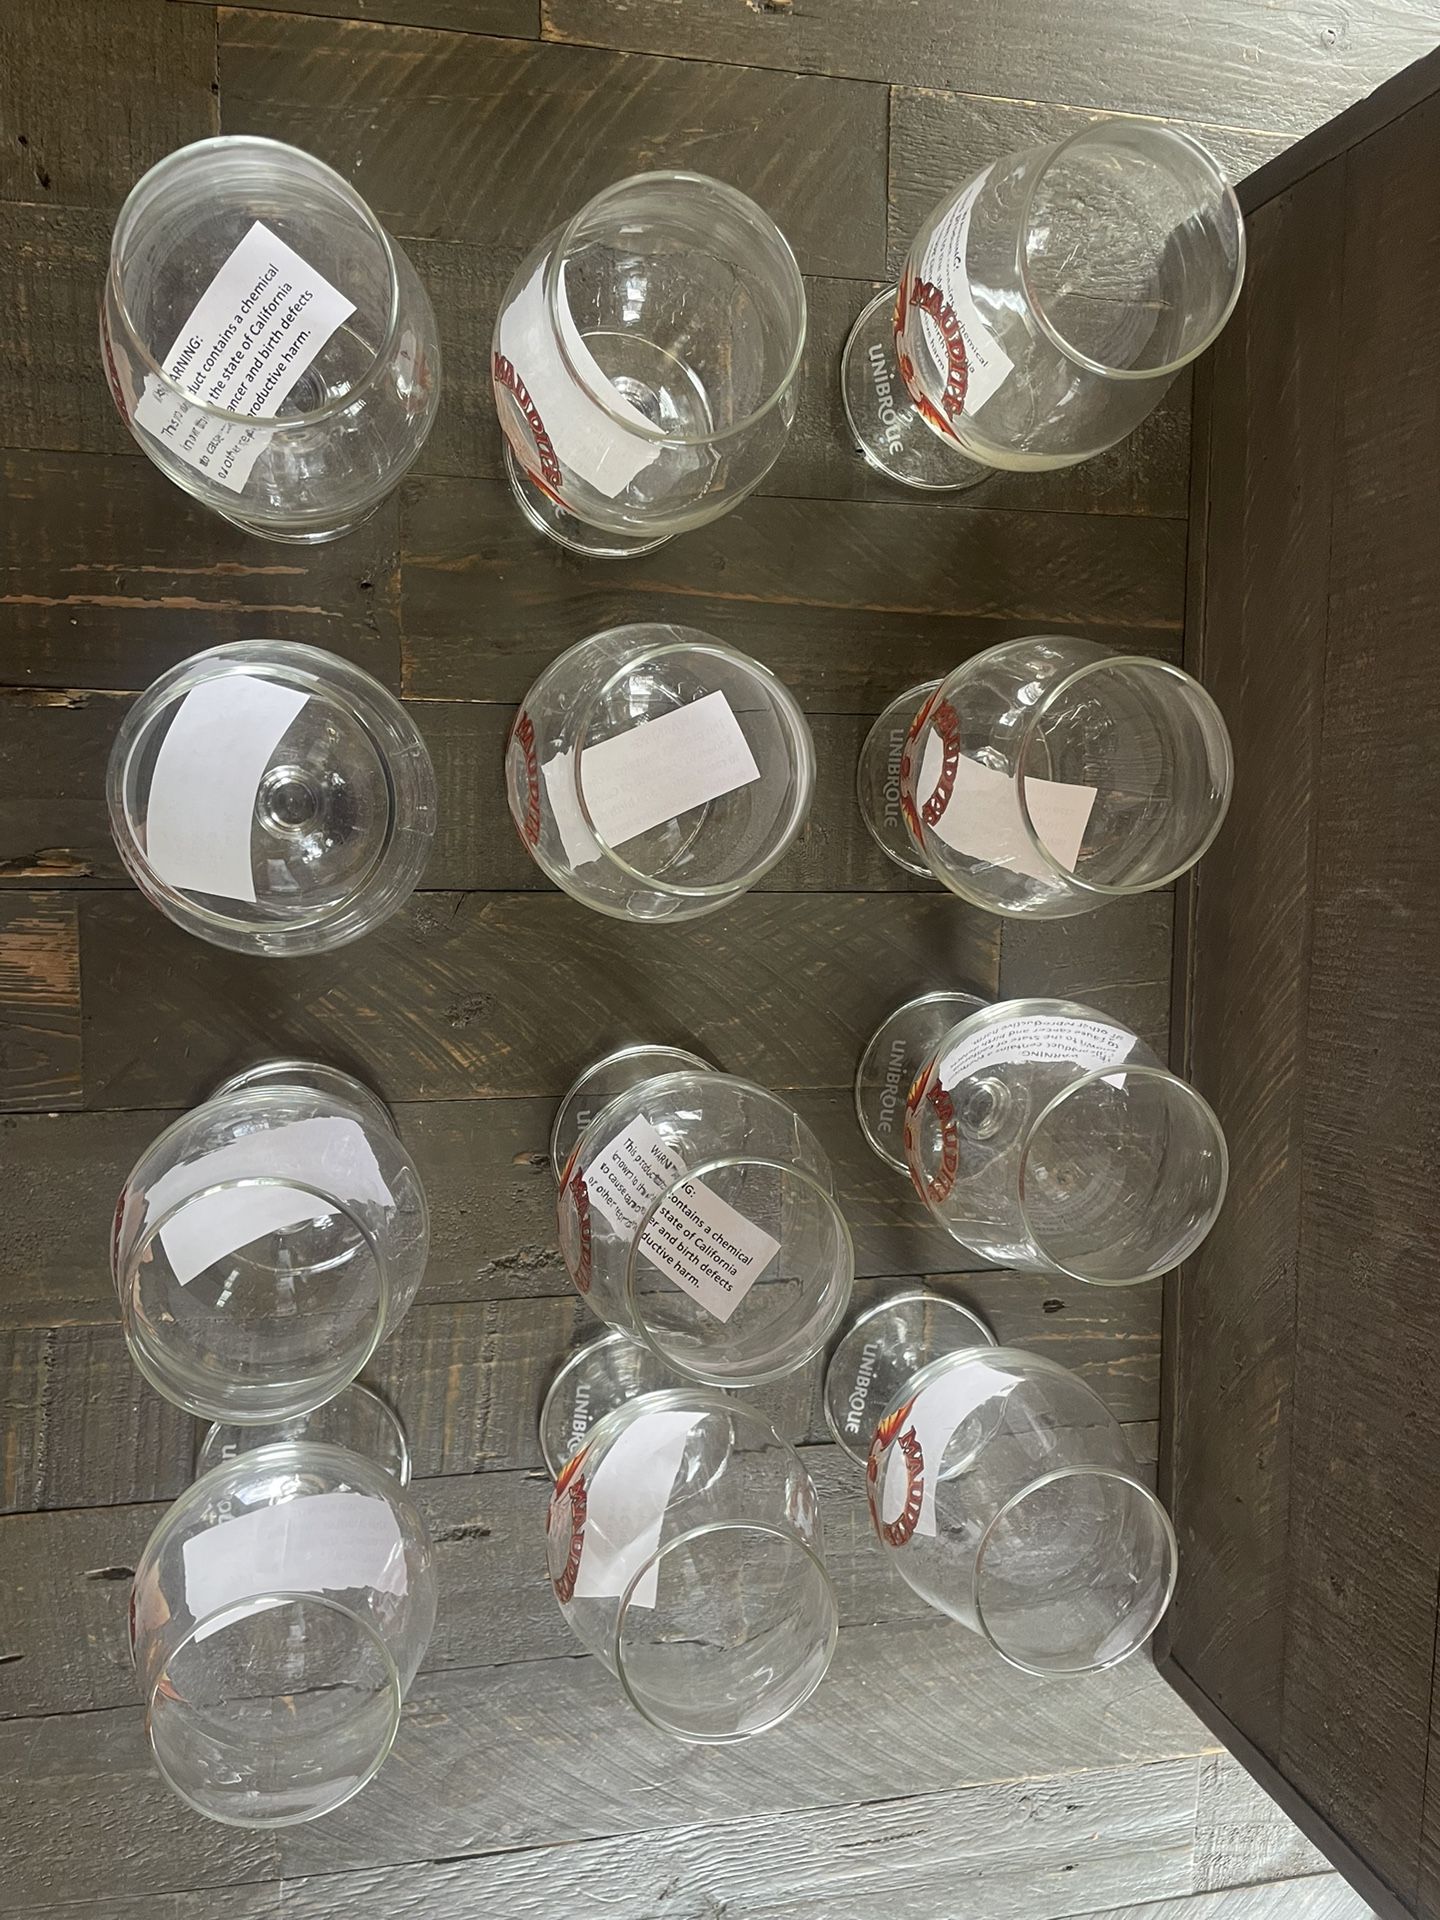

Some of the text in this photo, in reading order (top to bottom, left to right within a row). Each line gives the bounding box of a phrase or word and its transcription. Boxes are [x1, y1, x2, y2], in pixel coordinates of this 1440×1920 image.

[204, 324, 237, 372] contains
[236, 315, 244, 325] a
[242, 263, 280, 314] chemical
[212, 282, 293, 401] the state of California
[247, 358, 264, 383] and
[261, 329, 284, 361] birth
[281, 290, 313, 331] defects
[285, 330, 312, 363] harm.
[868, 342, 904, 456] UNIBROUE
[883, 728, 903, 828] UNIBROUE
[877, 1039, 907, 1134] UNIBROUE
[596, 1184, 616, 1207] other
[673, 1260, 701, 1288] harm.
[607, 1173, 628, 1196] cause
[658, 1225, 679, 1244] and
[677, 1241, 701, 1263] birth
[700, 1260, 734, 1292] defects
[622, 1137, 637, 1156] This
[704, 1224, 712, 1234] a
[712, 1231, 754, 1266] chemical
[659, 1206, 684, 1230] state
[684, 1226, 697, 1241] of
[695, 1236, 739, 1276] California
[845, 1344, 878, 1434] UNIBROUE
